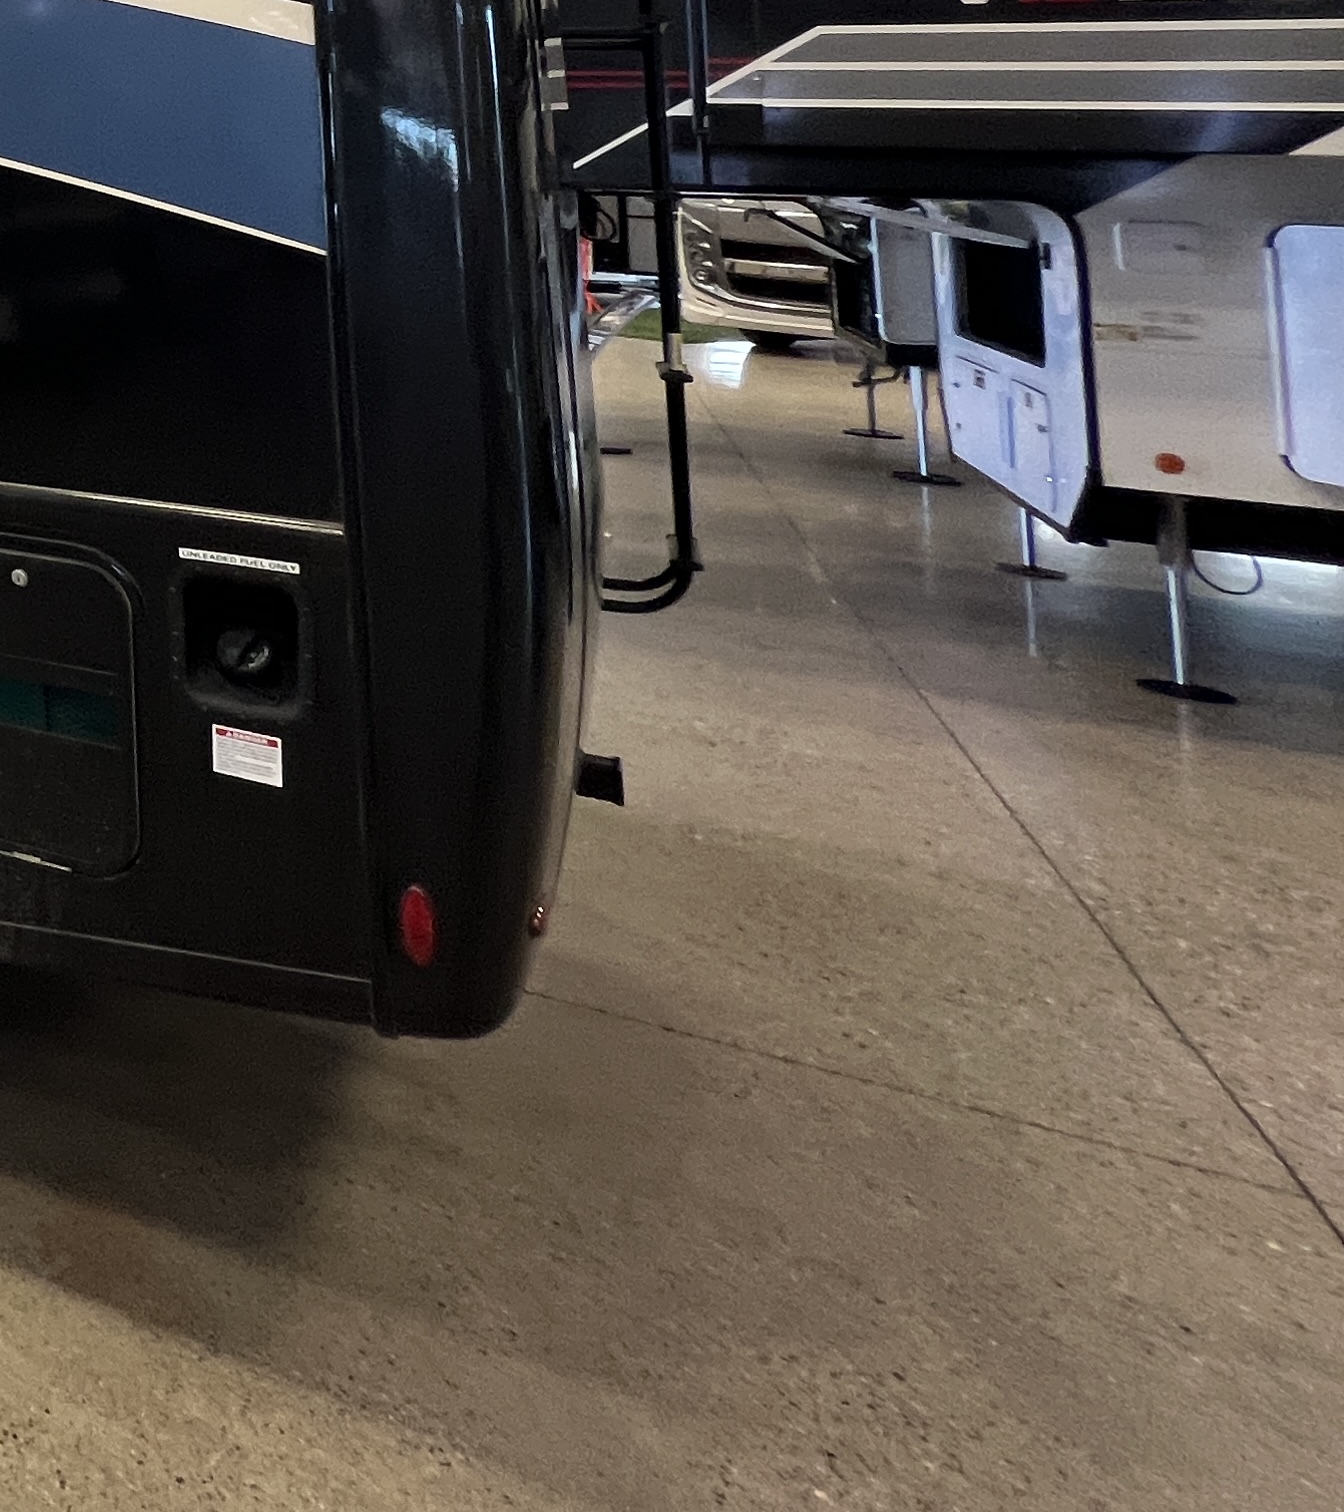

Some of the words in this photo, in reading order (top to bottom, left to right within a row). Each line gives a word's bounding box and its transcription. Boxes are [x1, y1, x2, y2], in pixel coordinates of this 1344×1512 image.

[181, 549, 237, 564] UNLEADED
[239, 556, 266, 568] FUEL
[268, 562, 297, 572] ONLY
